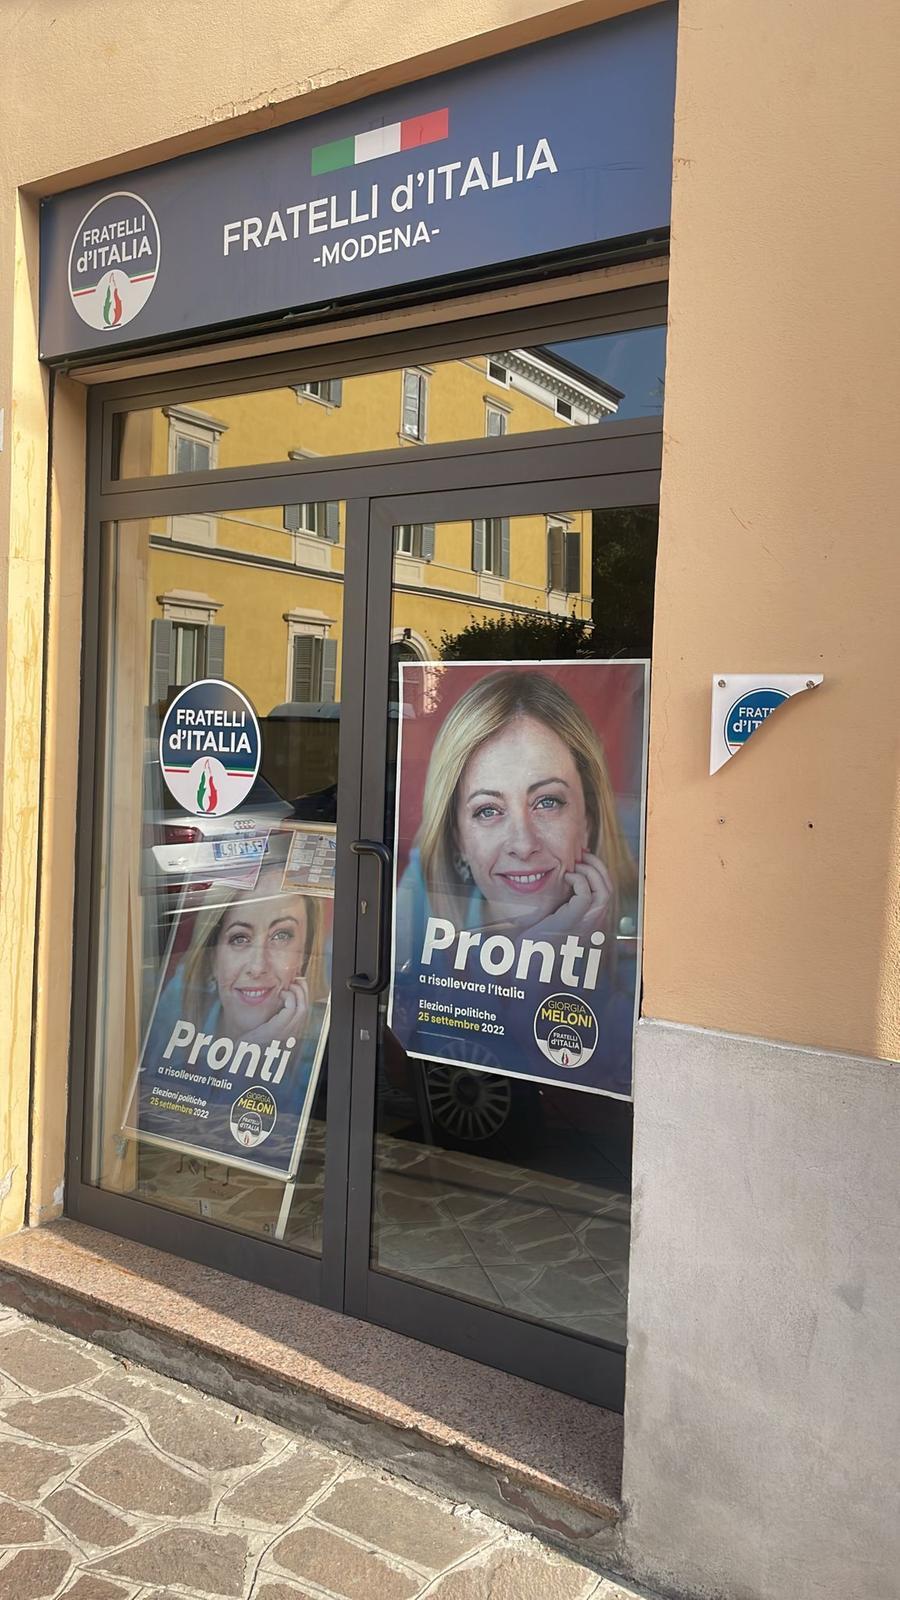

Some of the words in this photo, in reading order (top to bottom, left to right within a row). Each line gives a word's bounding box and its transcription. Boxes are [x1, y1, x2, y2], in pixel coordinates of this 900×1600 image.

[223, 183, 378, 256] FRATELLI
[391, 138, 558, 214] d'ITALIA
[83, 215, 146, 247] FRATELLI
[77, 235, 152, 273] d'ITALIA
[313, 221, 440, 267] -MODENA-
[176, 709, 245, 727] FRATELLI
[169, 729, 252, 753] d'ITALIA
[420, 917, 605, 990] Pronti
[419, 974, 427, 983] a
[427, 973, 486, 993] risollevare
[419, 999, 453, 1014] Elezioni
[454, 1004, 497, 1021] politiche
[541, 1008, 592, 1028] MELONI
[547, 1000, 586, 1014] GIORGIA
[418, 1012, 430, 1021] 25
[431, 1014, 480, 1031] settembre
[481, 1024, 505, 1035] 2022
[553, 1032, 578, 1041] FRATELLI
[162, 1020, 296, 1084] Pronti
[158, 1066, 164, 1074] a
[164, 1066, 207, 1085] risollevare
[150, 1096, 159, 1105] 25
[159, 1098, 193, 1114] settembre
[193, 1107, 209, 1119] 2022
[152, 1087, 178, 1100] Elezioni
[177, 1092, 207, 1107] politiche
[237, 1097, 274, 1115] MELONI
[246, 1091, 271, 1103] GIORGIA
